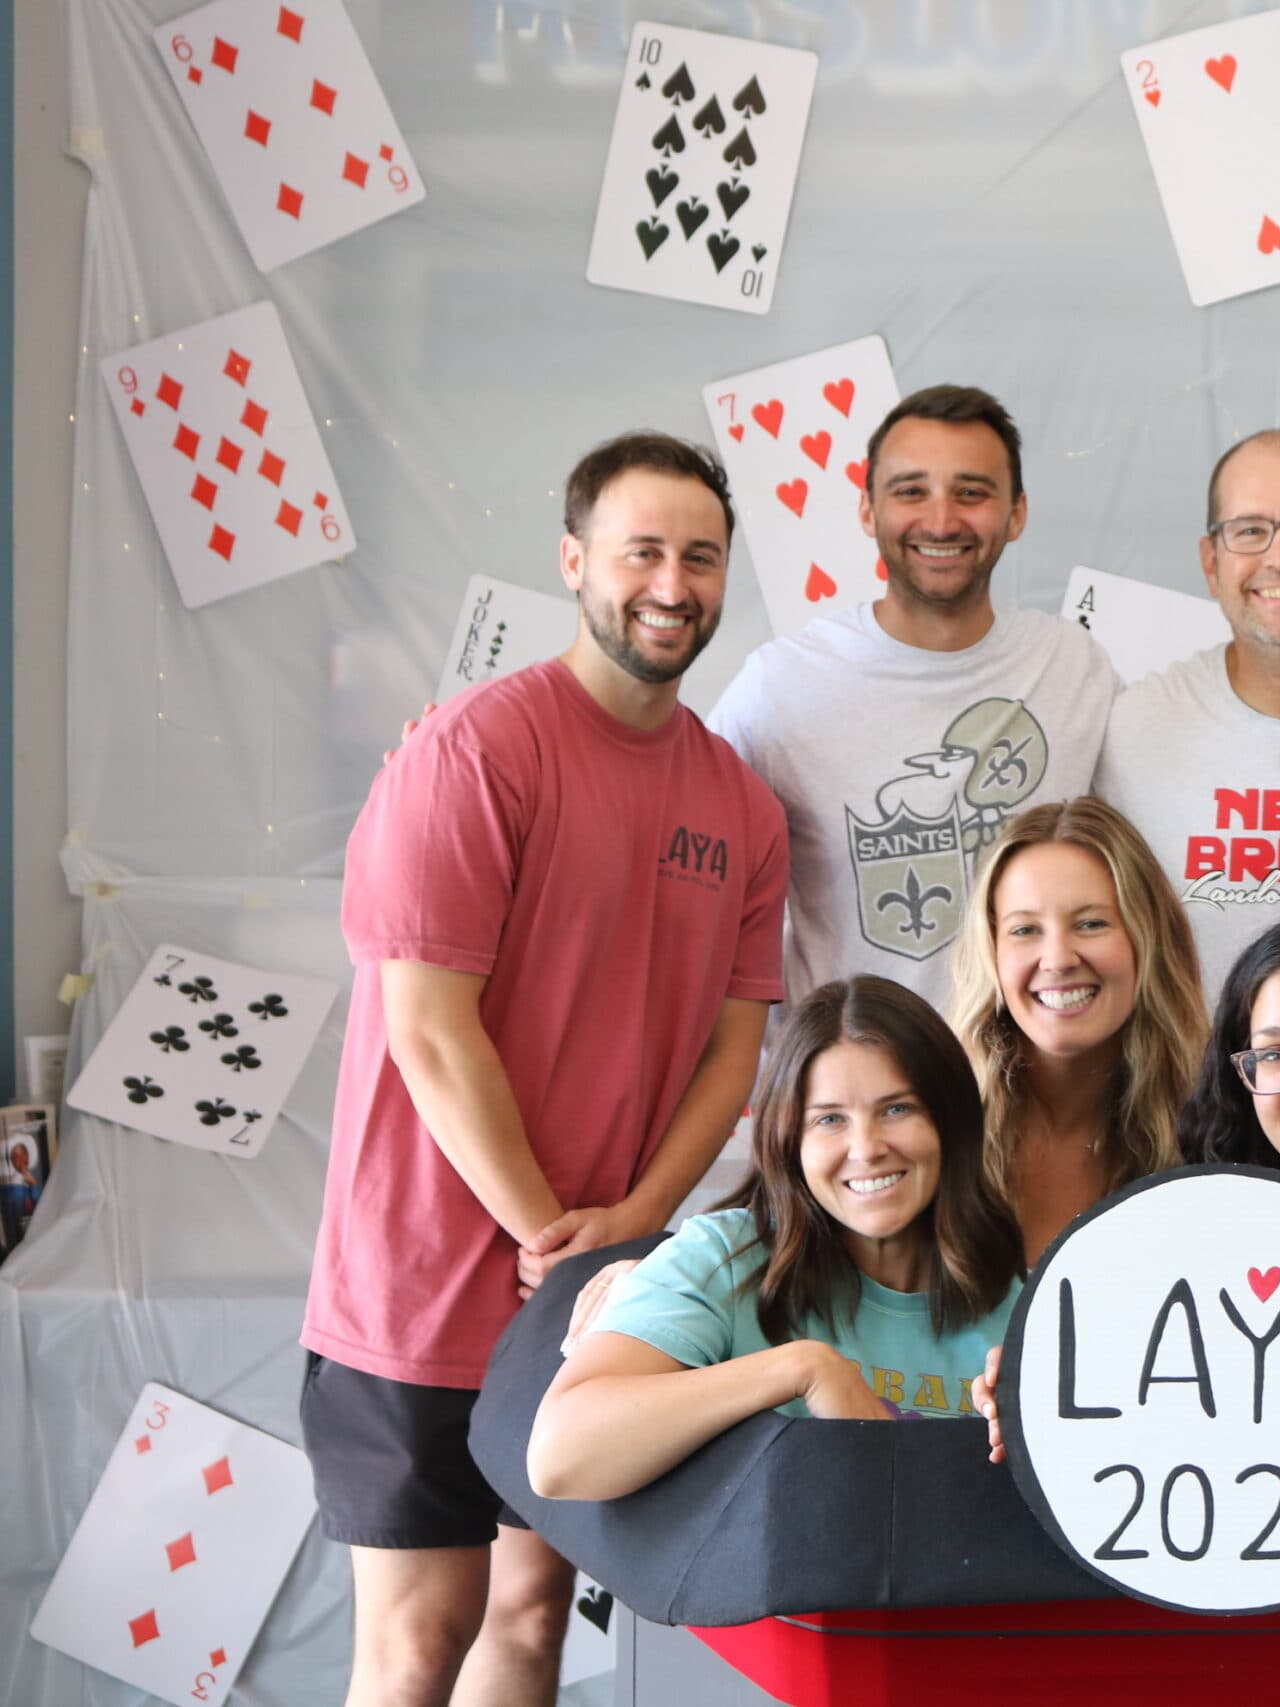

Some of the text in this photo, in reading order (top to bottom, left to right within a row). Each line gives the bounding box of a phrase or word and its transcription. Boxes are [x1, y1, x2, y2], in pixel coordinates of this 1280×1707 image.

[171, 34, 193, 63] 6
[639, 37, 662, 65] 10
[1136, 60, 1159, 89] 2
[740, 269, 763, 297] 10
[118, 366, 138, 394] 9
[716, 392, 737, 421] 7
[1076, 584, 1096, 612] A
[456, 589, 493, 682] JOKER
[658, 825, 728, 883] AYA
[858, 828, 954, 859] SAINTS
[165, 954, 185, 972] 7
[146, 1400, 171, 1431] 3
[191, 1671, 217, 1702] 3
